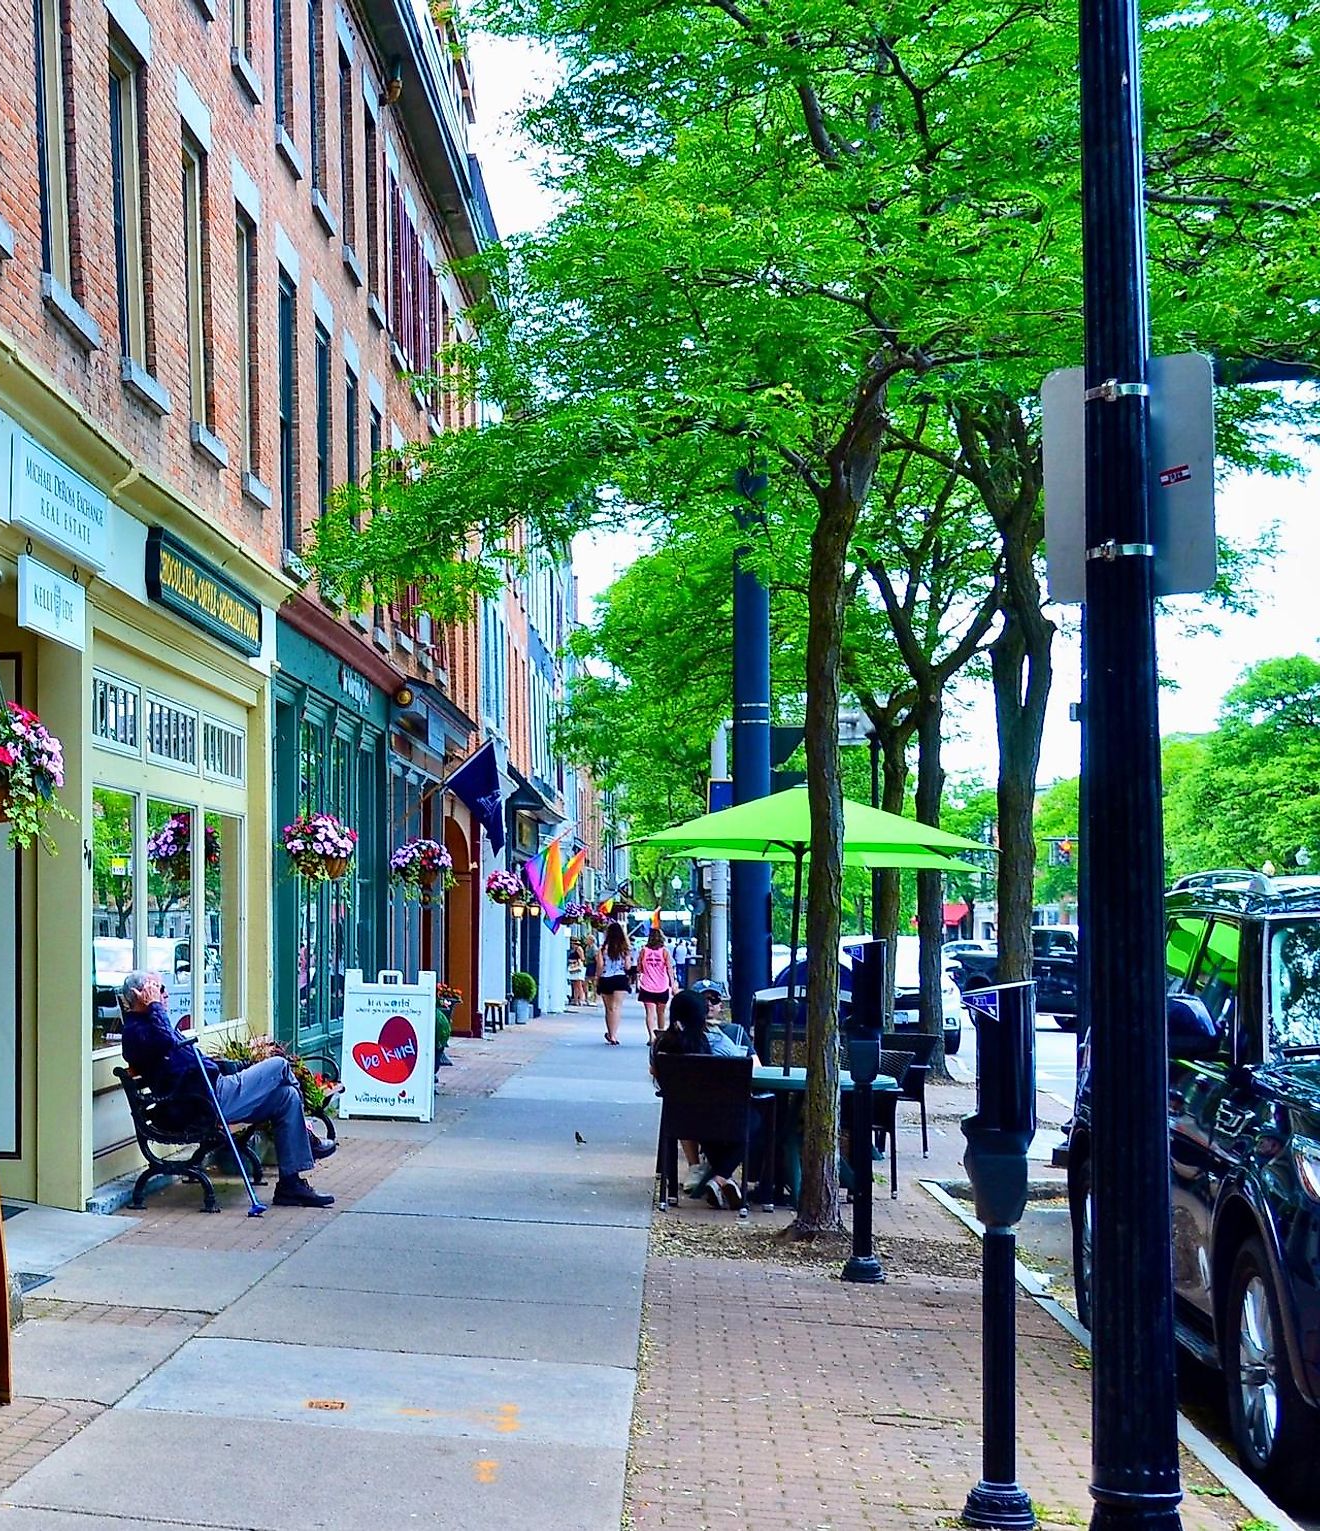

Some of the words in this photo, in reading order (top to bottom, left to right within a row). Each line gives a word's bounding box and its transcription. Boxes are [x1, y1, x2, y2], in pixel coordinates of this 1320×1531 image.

[41, 497, 59, 526] REAL
[64, 512, 90, 544] ESTATE
[84, 839, 91, 870] 50
[360, 1053, 380, 1071] be
[380, 1038, 416, 1064] kind
